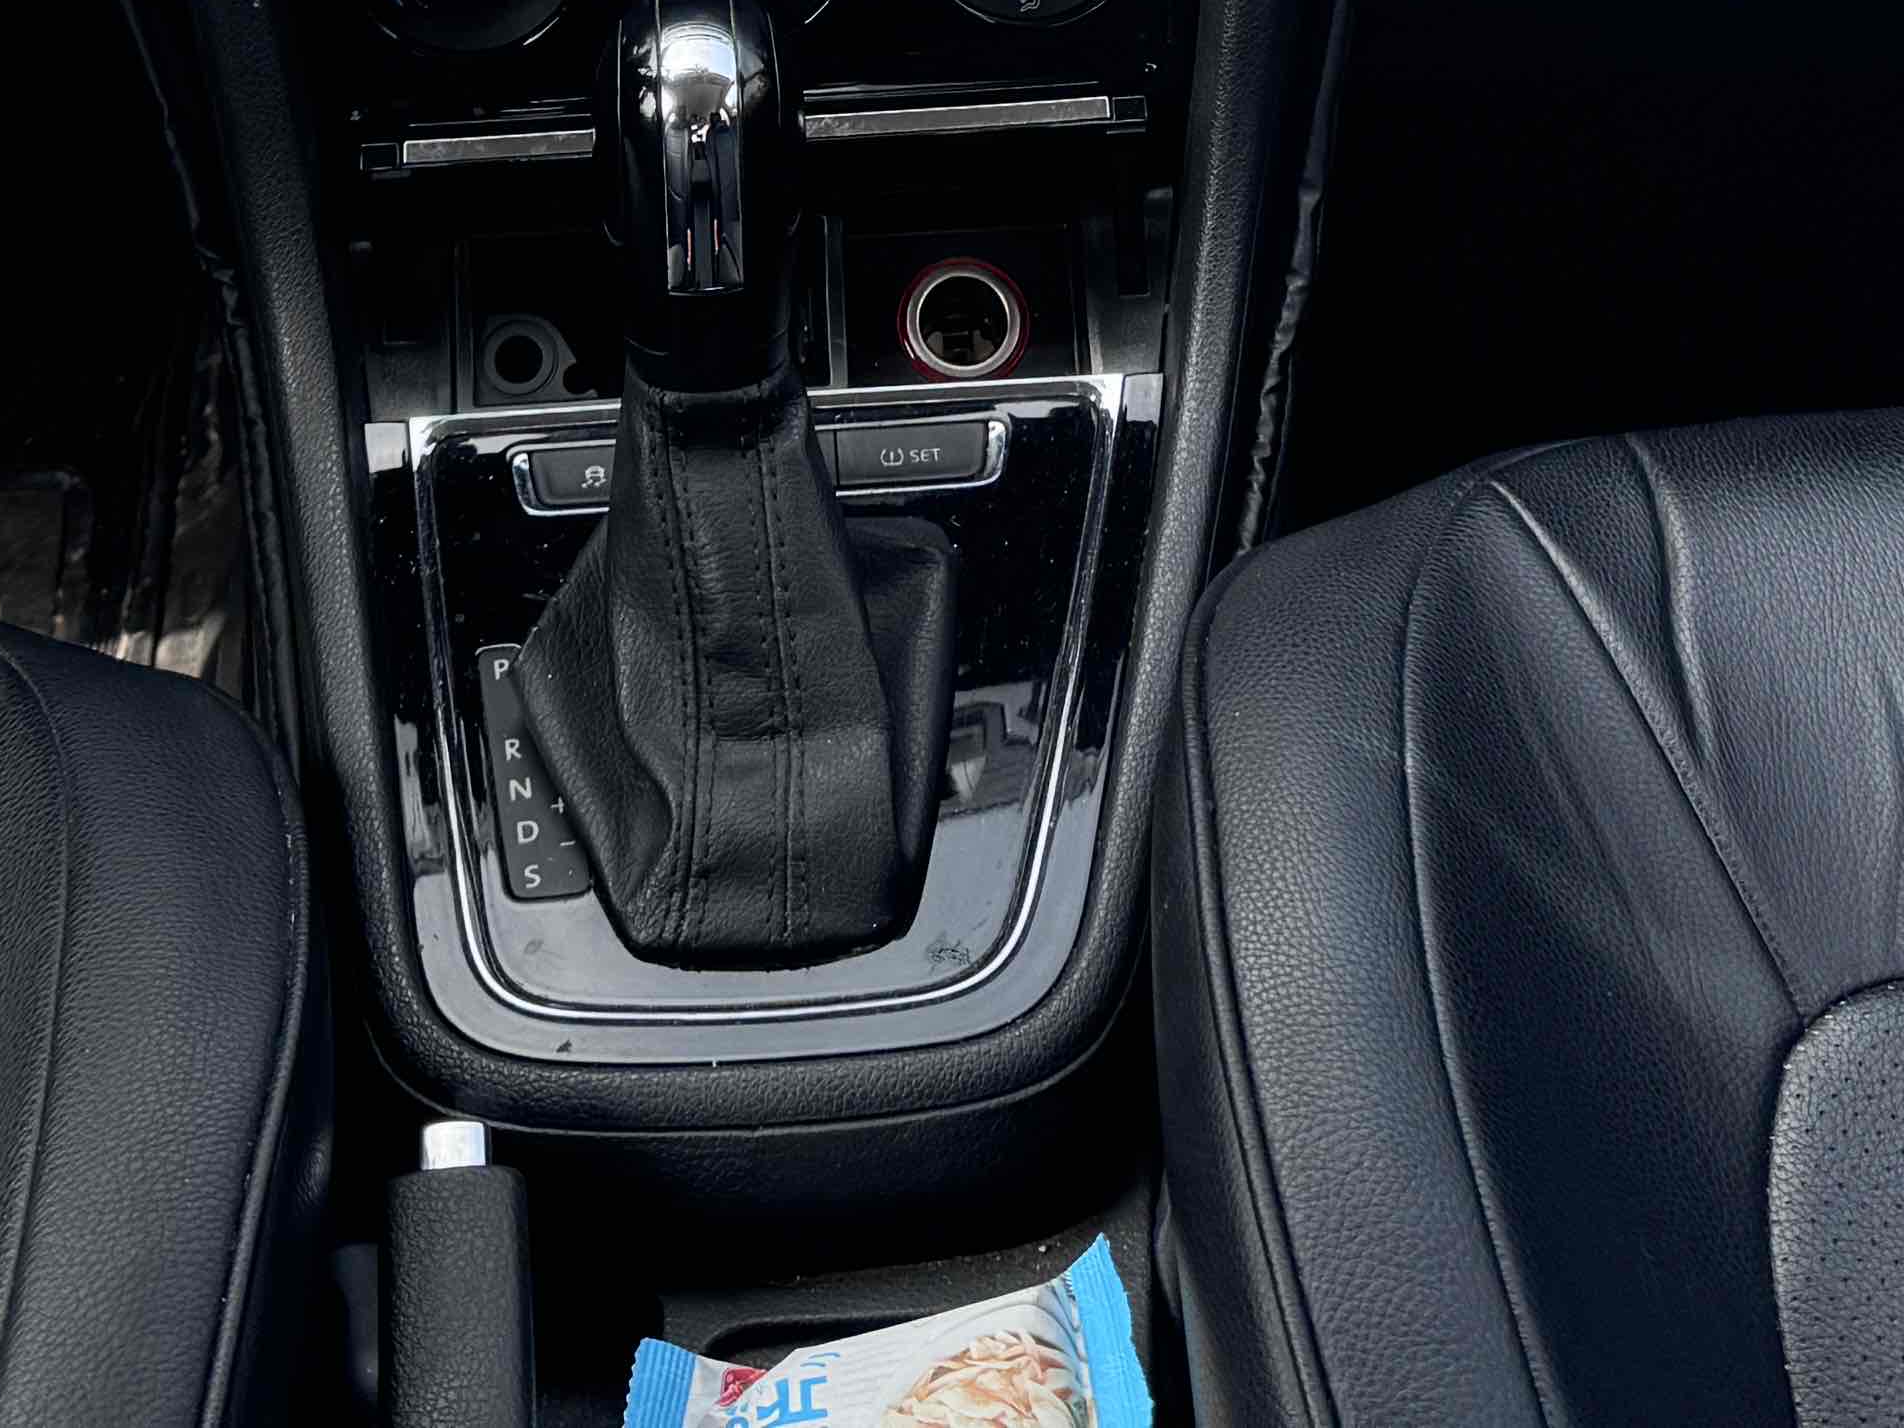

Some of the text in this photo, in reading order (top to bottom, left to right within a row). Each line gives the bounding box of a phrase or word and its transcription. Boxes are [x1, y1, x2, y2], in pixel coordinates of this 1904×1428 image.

[907, 446, 942, 465] SET
[493, 658, 510, 682] P
[505, 738, 521, 761] R
[509, 777, 531, 803] N
[517, 818, 540, 844] D
[523, 863, 542, 889] S
